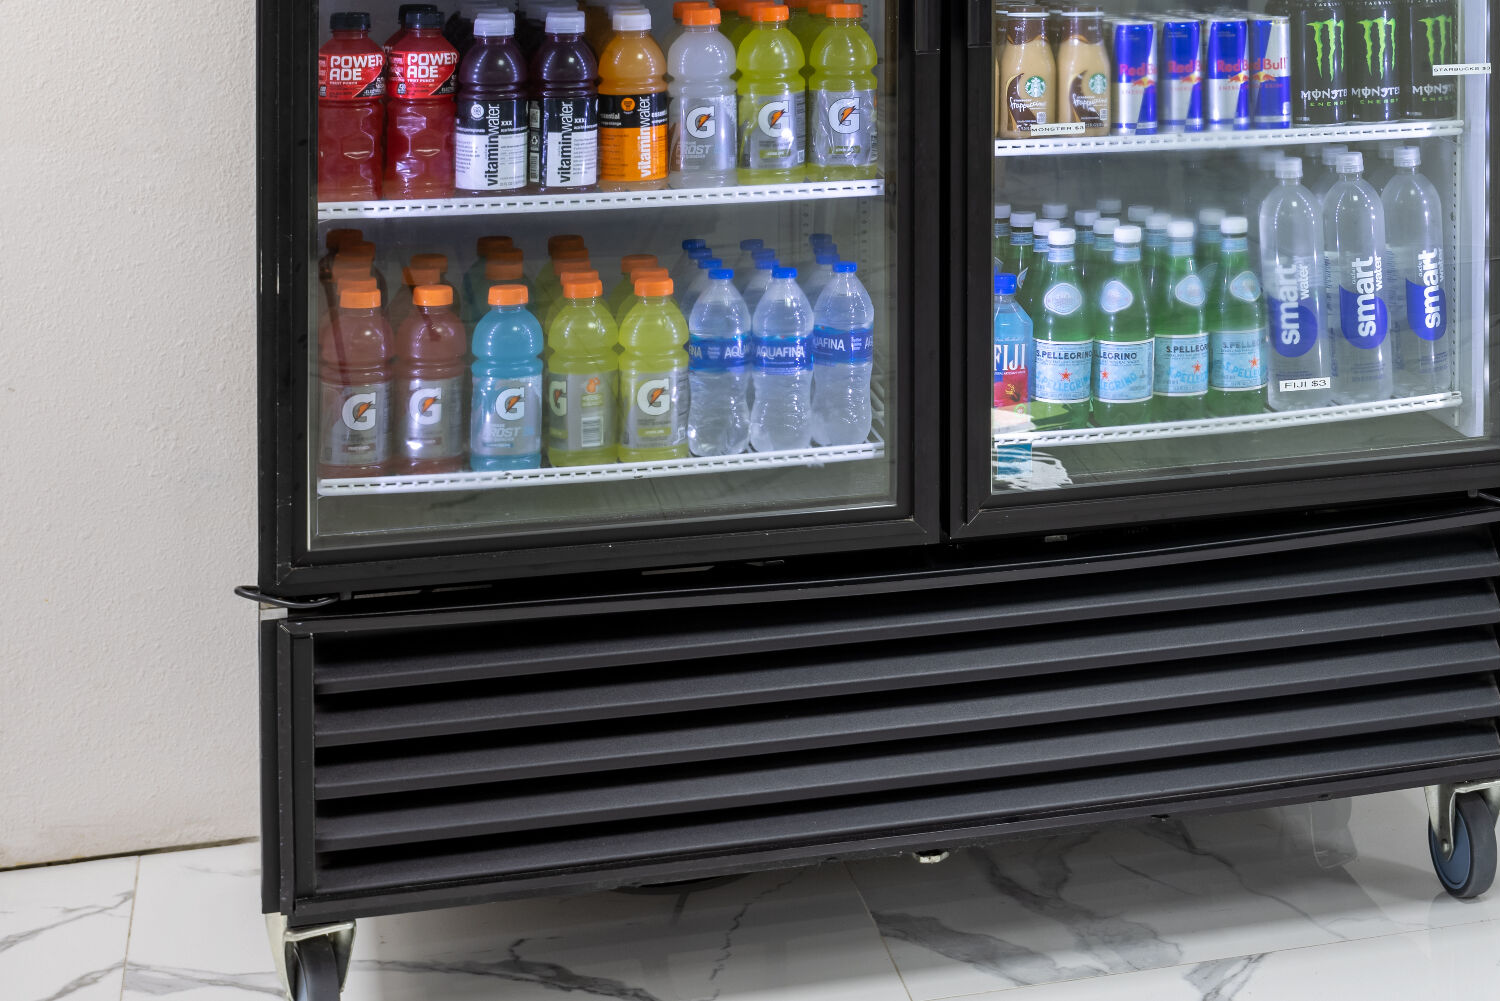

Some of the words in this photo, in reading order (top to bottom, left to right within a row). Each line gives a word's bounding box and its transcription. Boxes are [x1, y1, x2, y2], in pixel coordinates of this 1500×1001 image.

[329, 68, 363, 81] ADE
[330, 54, 384, 69] POWER
[406, 65, 440, 79] ADE
[407, 52, 458, 67] POWER
[1119, 62, 1147, 77] Red
[1167, 60, 1194, 73] Red
[1216, 59, 1242, 73] Red
[1263, 57, 1288, 70] Bull
[686, 105, 716, 139] G
[757, 99, 789, 138] G
[827, 97, 860, 134] G
[485, 103, 500, 187] vitaminwater
[557, 101, 573, 184] vitaminwater
[636, 96, 650, 178] vitaminwater
[1300, 263, 1309, 300] water
[1374, 255, 1382, 292] water
[1418, 247, 1441, 330] smart
[1275, 263, 1300, 345] smart
[1351, 256, 1376, 338] smart
[756, 344, 806, 360] AQUAFINA
[993, 343, 1026, 372] FIJI
[637, 378, 671, 416] G
[1284, 381, 1307, 389] FIJI
[1311, 379, 1327, 388] $3
[341, 391, 377, 431] G
[409, 387, 443, 425] G
[495, 386, 525, 421] G
